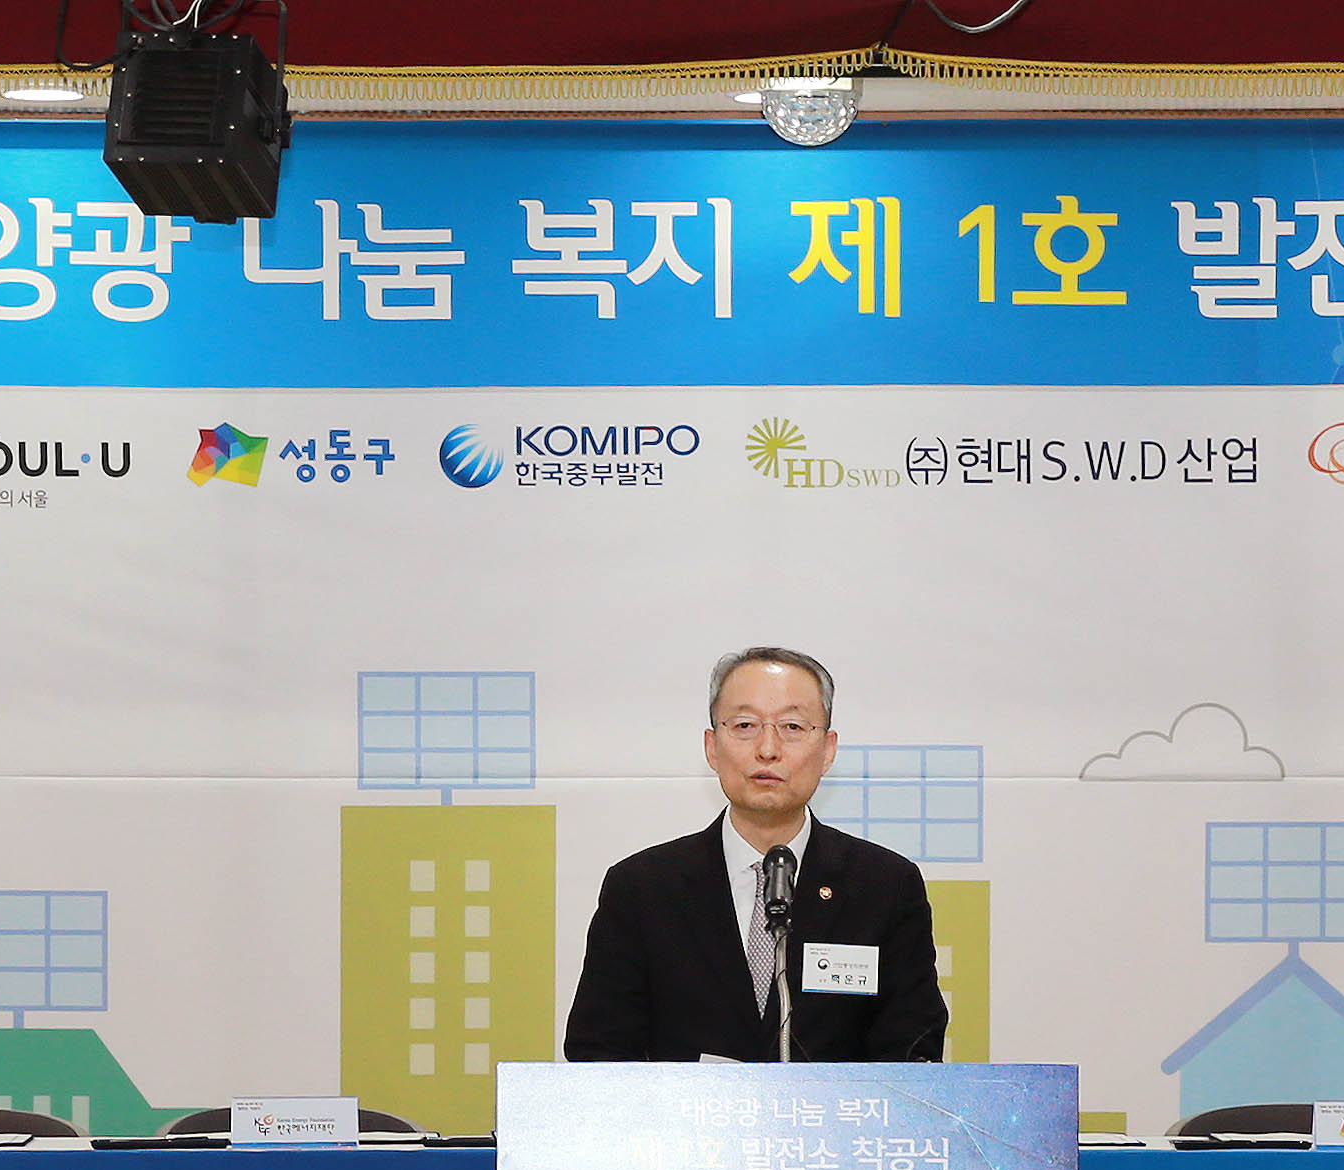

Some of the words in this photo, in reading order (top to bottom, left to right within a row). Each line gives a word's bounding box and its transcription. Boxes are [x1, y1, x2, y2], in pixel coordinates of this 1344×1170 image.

[242, 198, 465, 322] 나눔
[511, 196, 734, 320] 복지
[787, 195, 902, 319] 제
[957, 194, 1128, 305] 1호
[278, 429, 396, 483] 성동구
[516, 424, 700, 457] KOMIPO
[514, 461, 663, 487] 한국중부발전
[17, 489, 49, 509] 서울
[681, 1098, 762, 1128] 태양광
[772, 1096, 829, 1129] 나눔
[835, 1096, 892, 1129] 복지
